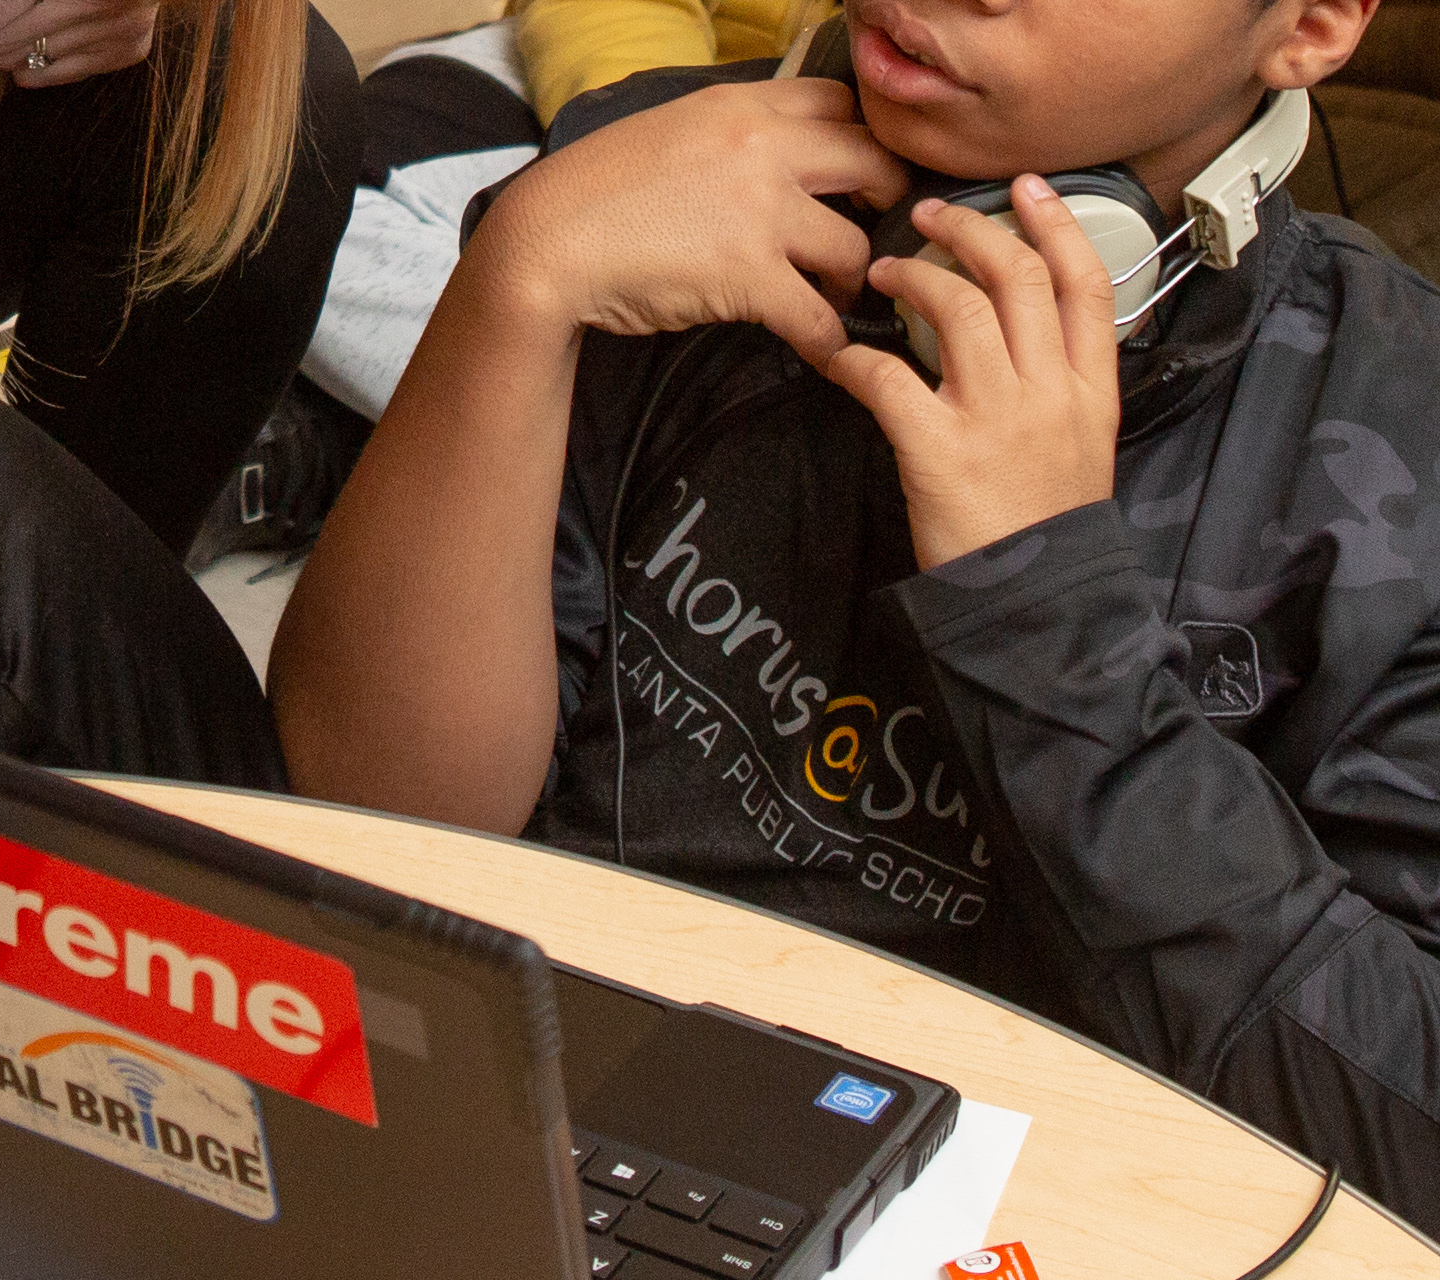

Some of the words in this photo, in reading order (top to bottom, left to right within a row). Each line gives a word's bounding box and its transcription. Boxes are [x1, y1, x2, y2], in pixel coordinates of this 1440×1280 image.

[588, 1209, 609, 1225] Z
[759, 1217, 784, 1231] Ctrl
[592, 1256, 609, 1271] A
[722, 1253, 752, 1270] Shift
